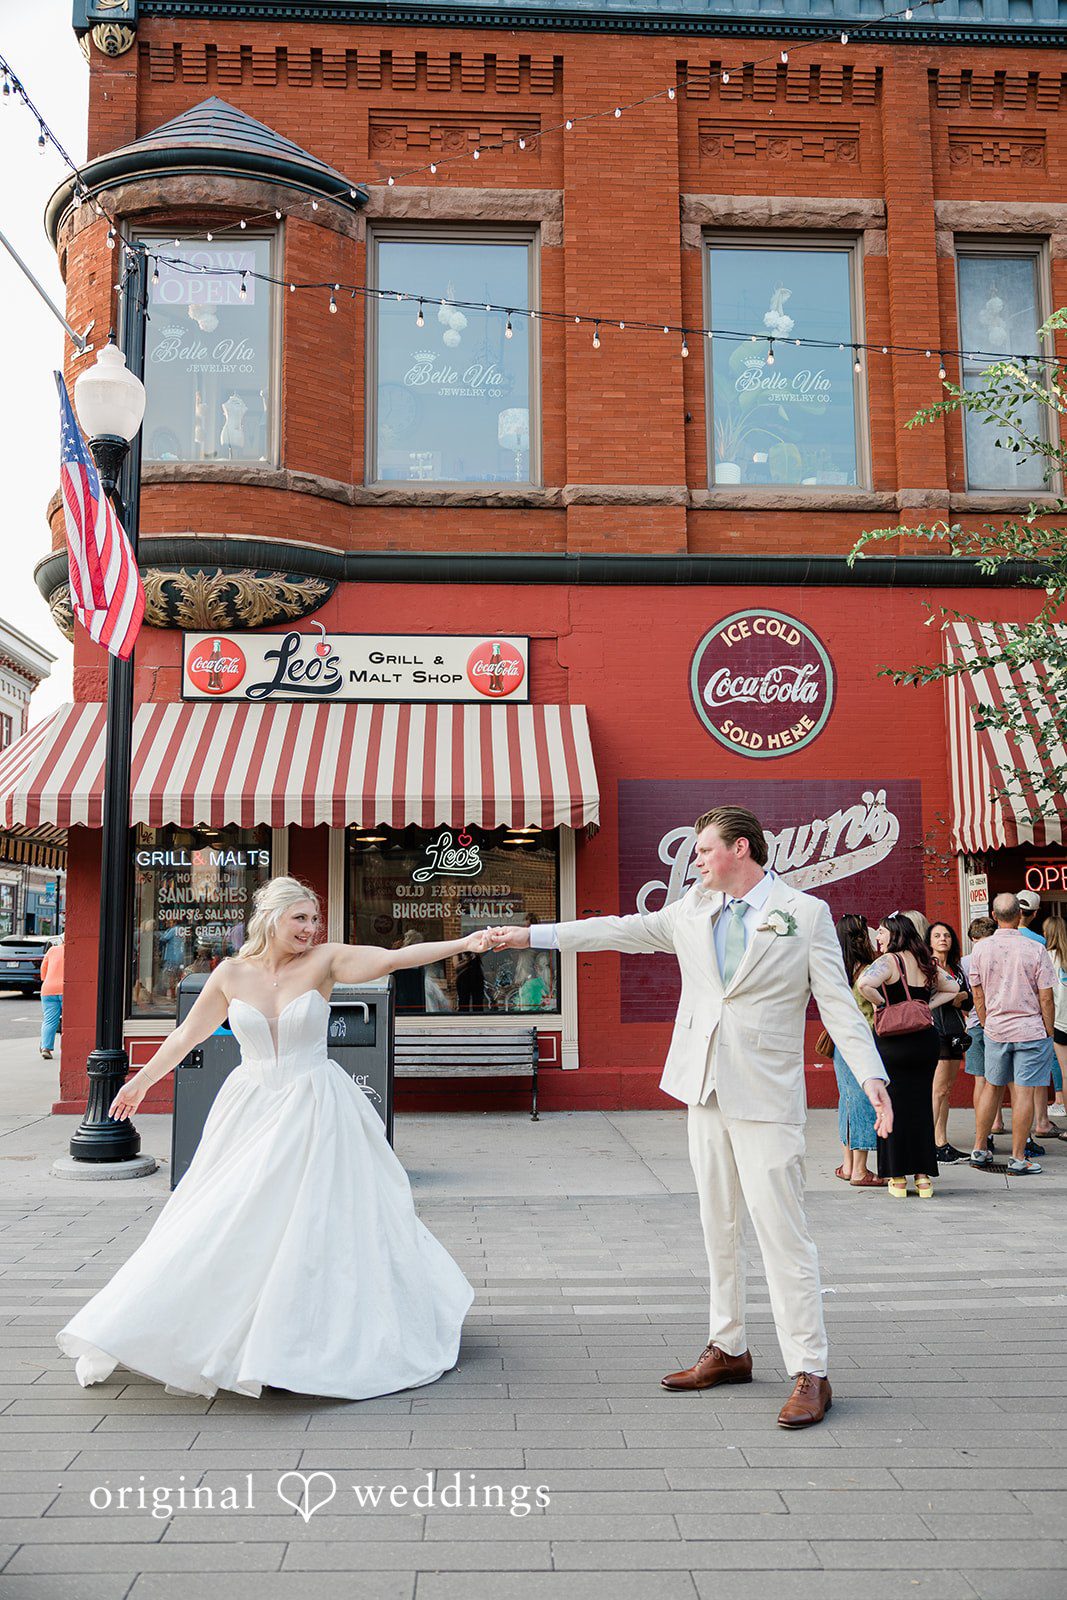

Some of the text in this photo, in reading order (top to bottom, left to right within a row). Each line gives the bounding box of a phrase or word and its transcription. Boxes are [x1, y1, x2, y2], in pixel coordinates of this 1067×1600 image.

[161, 251, 246, 276] NOW
[160, 279, 246, 304] OPEN
[151, 338, 256, 363] Belle Via
[186, 364, 255, 374] JEWELRY CO.
[404, 361, 504, 388] Belle Via
[735, 368, 832, 394] Belle Via
[438, 388, 504, 398] JEWELRY CO.
[768, 393, 832, 403] JEWELRY CO.
[720, 618, 801, 648] ICE COLD
[191, 656, 240, 674] Coca-Cola
[433, 655, 444, 665] &
[472, 659, 520, 676] Coca-Cola
[703, 664, 820, 708] Coca-Cola
[720, 714, 815, 749] SOLD HERE
[137, 850, 270, 867] GRILL & MALTS
[177, 873, 231, 884] HOT COLD
[158, 887, 248, 904] SANDWICHES
[396, 885, 424, 897] OLD
[431, 885, 511, 897] FASHIONED
[970, 889, 987, 903] OPEN
[158, 908, 245, 921] SOUPS & SALADS
[393, 902, 514, 919] BURGERS & MALTS
[175, 926, 232, 937] ICE CREAM
